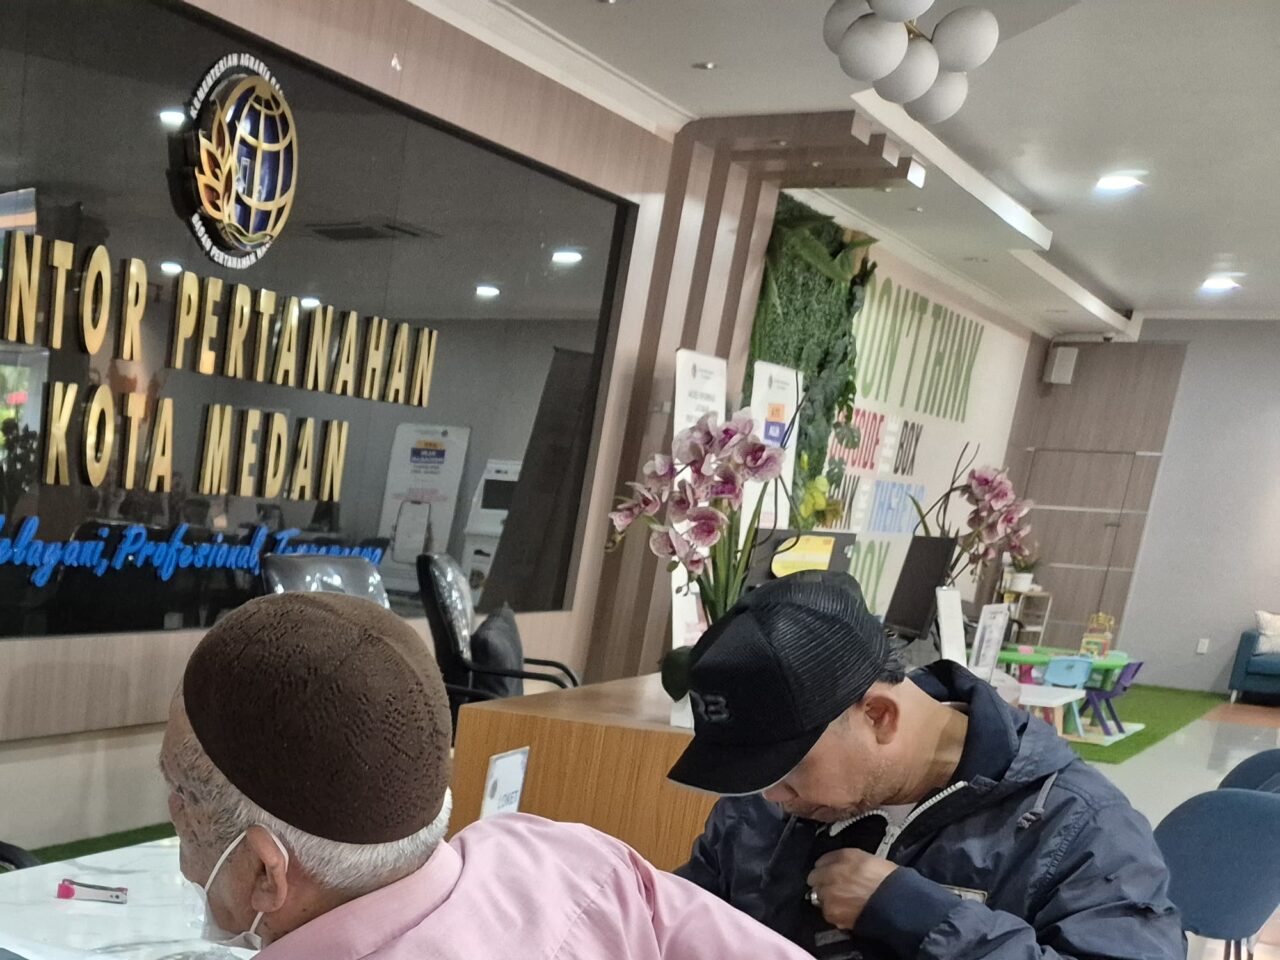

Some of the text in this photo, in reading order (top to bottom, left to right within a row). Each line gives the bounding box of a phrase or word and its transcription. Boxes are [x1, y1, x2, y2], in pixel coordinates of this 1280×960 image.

[239, 53, 271, 82] AGRARIA
[191, 212, 213, 251] BADAN
[210, 245, 257, 269] PERTANAHAN
[172, 271, 438, 408] PERTANAHAN
[44, 381, 349, 502] KOTA MEDAN
[830, 408, 884, 470] TSIDE
[893, 420, 923, 476] BOX
